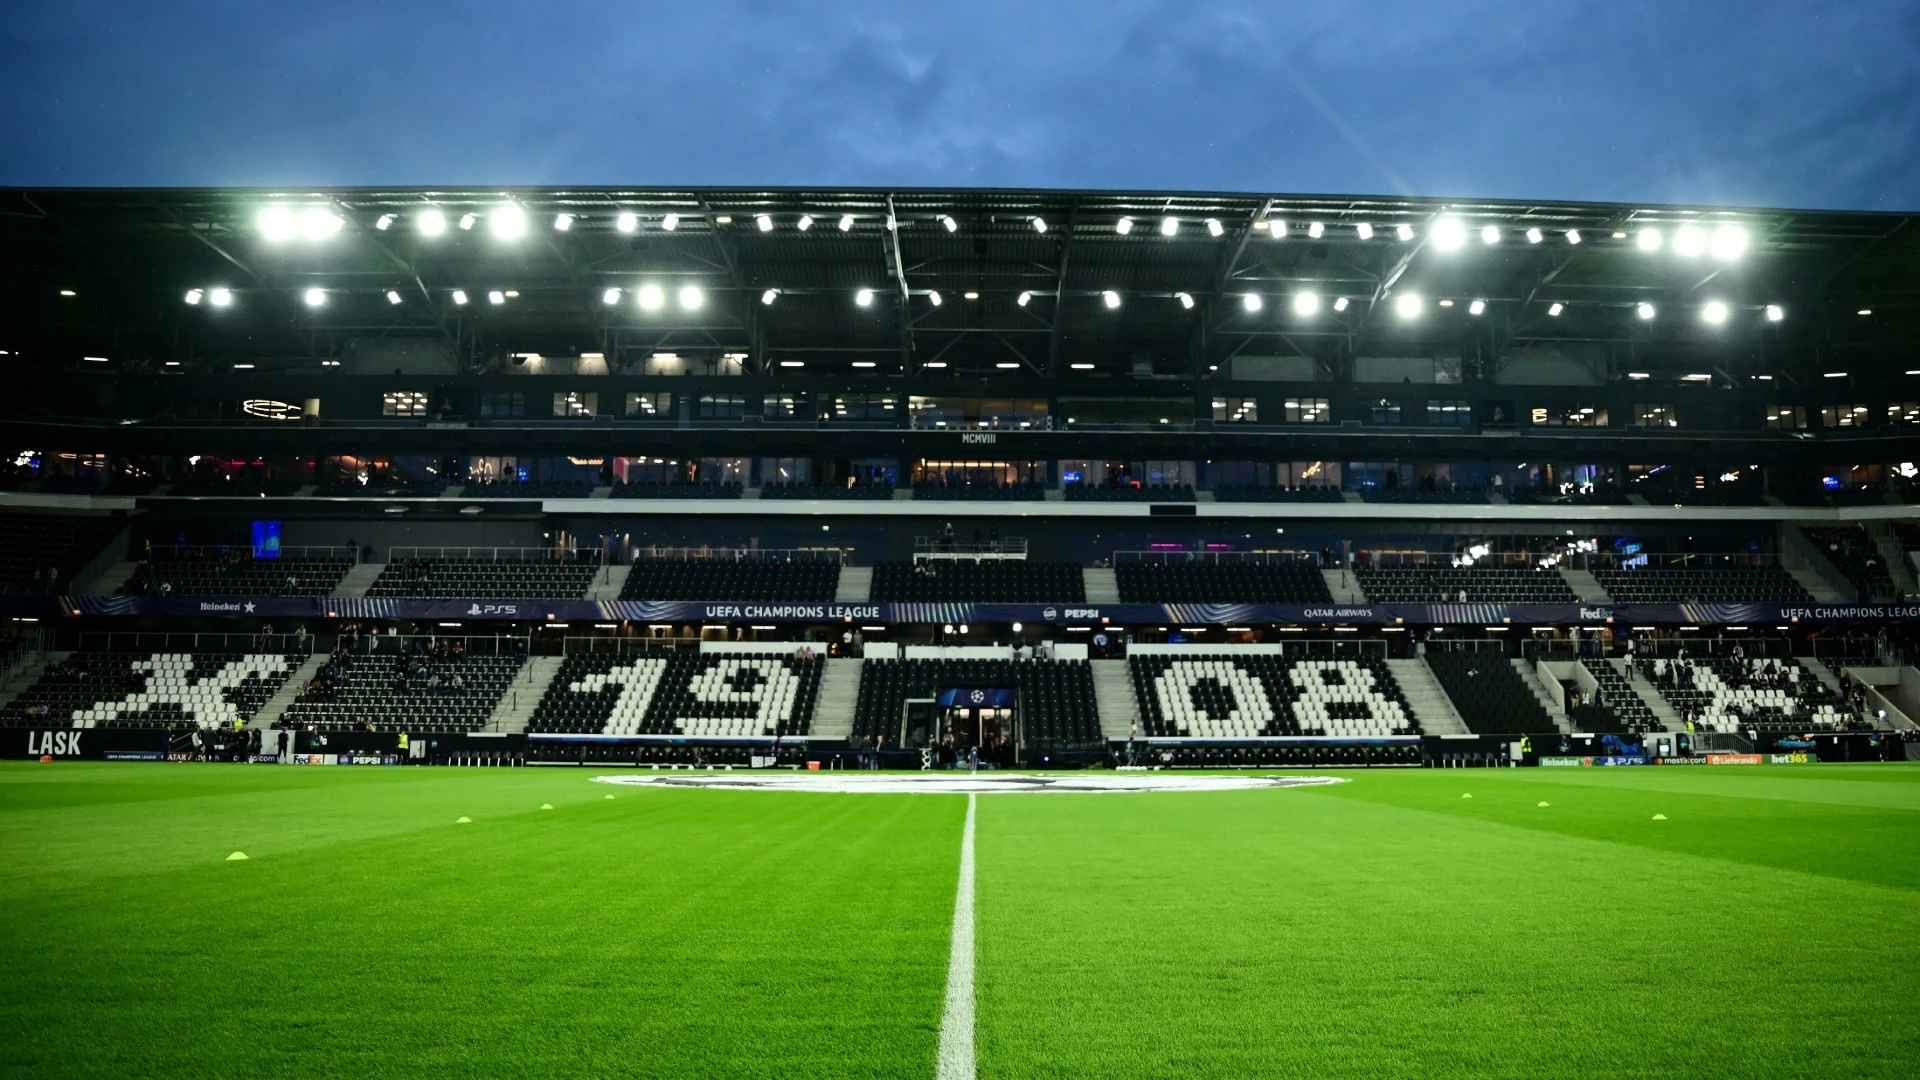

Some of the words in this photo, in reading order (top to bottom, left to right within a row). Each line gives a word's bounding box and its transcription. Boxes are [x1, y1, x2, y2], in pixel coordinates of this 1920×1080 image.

[962, 433, 996, 444] MCMVIII
[200, 602, 241, 611] Heineken
[484, 605, 517, 614] PS5
[706, 606, 740, 618] UEFA
[744, 606, 823, 618] CHAMPIONS
[828, 606, 880, 618] LEAGUE
[1064, 609, 1099, 619] PEPSI
[1304, 609, 1334, 618] QATAR
[1335, 609, 1373, 618] AIRWAYS
[1580, 608, 1613, 620] FedEx
[1781, 608, 1812, 619] UEFA
[1815, 606, 1884, 619] CHAMPIONS
[28, 731, 82, 755] LASK
[161, 753, 187, 761] ATAR
[294, 755, 321, 764] FedEx
[1617, 757, 1643, 765] PS5
[1720, 756, 1758, 765] Lieferando
[1772, 754, 1808, 763] bet365
[1542, 758, 1579, 766] Heineken
